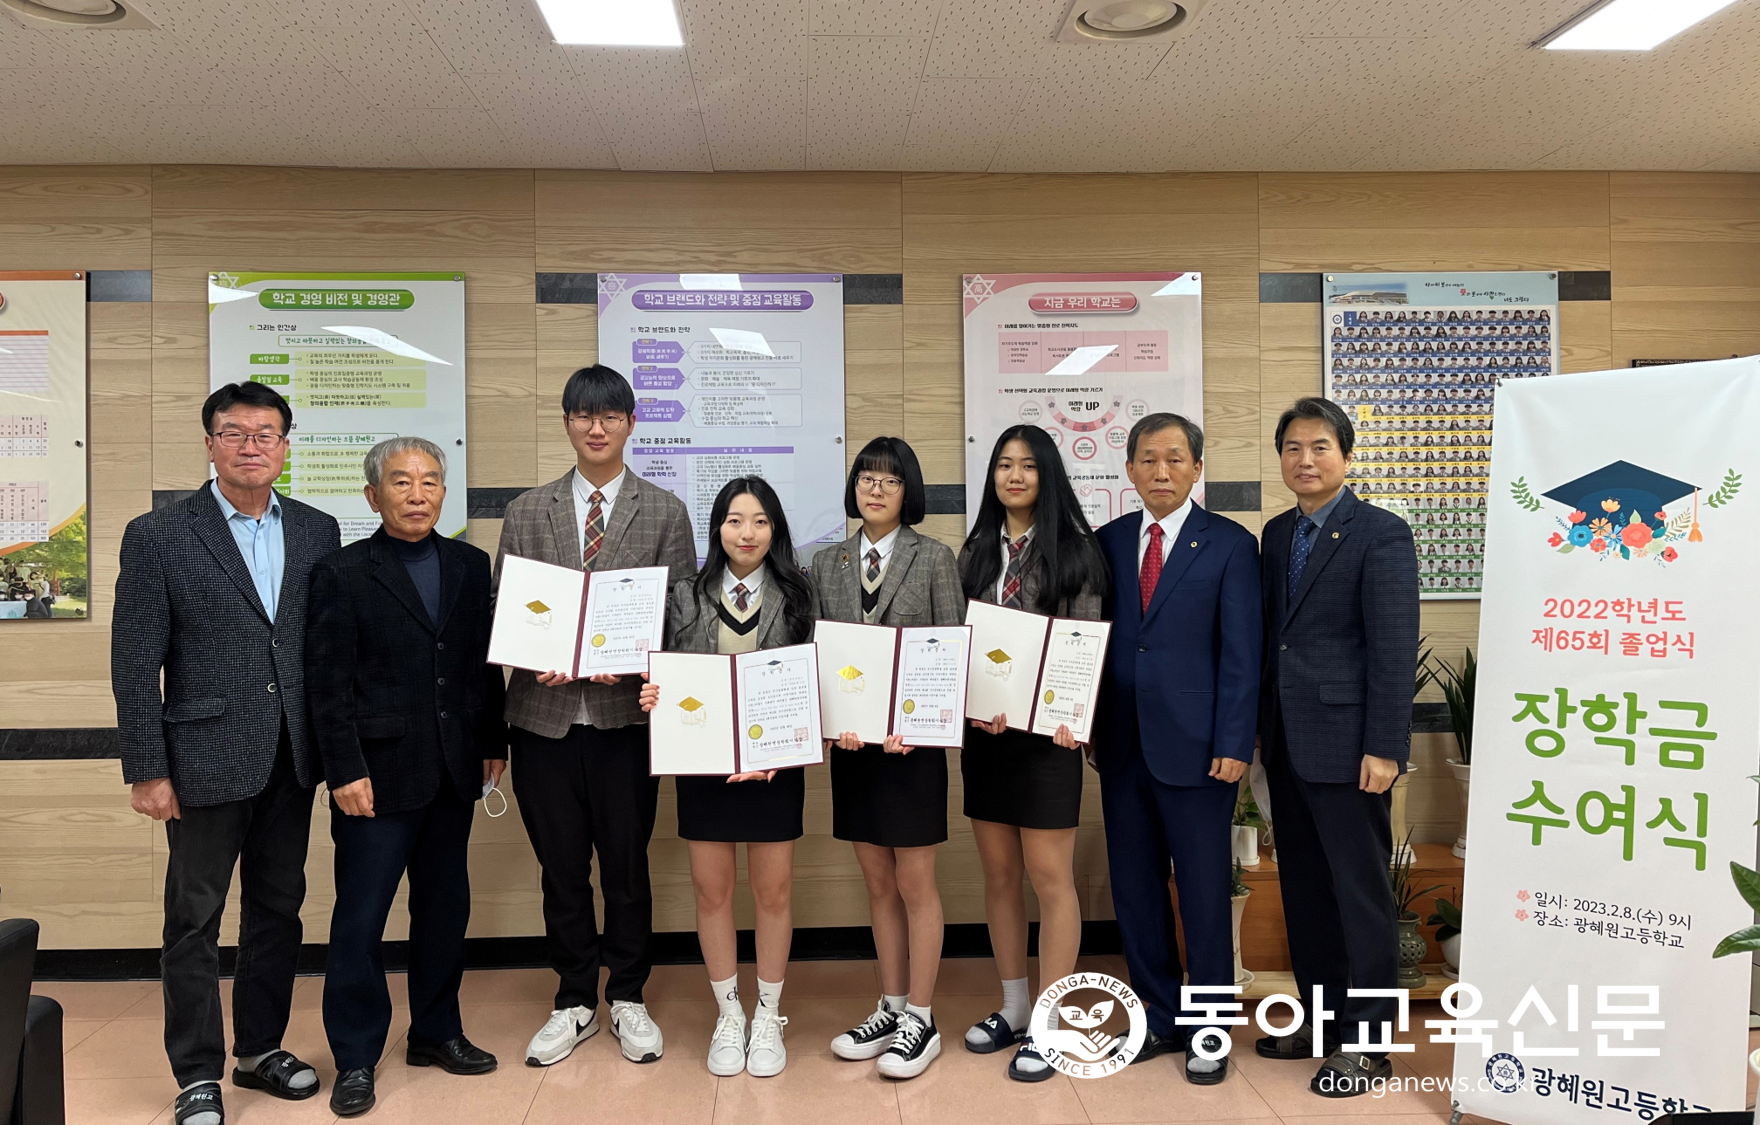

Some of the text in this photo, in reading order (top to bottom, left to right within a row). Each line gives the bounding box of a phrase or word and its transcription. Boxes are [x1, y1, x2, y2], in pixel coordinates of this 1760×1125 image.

[272, 292, 401, 305] 학교 경영 비전 및 경영관
[644, 294, 802, 306] 학교 브랜드화 전략 및 중점 교육활동
[1044, 297, 1121, 308] 지금 우리 학교는
[1086, 402, 1100, 410] UP
[1543, 597, 1687, 624] 2022학년도
[1531, 627, 1695, 659] 제65회 졸업식
[1512, 687, 1718, 770] 장학금
[1506, 780, 1709, 872] 수여식
[1534, 892, 1691, 931] 일시: 2023.2.8.(수) 9시
[1533, 910, 1685, 949] 장소: 광혜원고등학교
